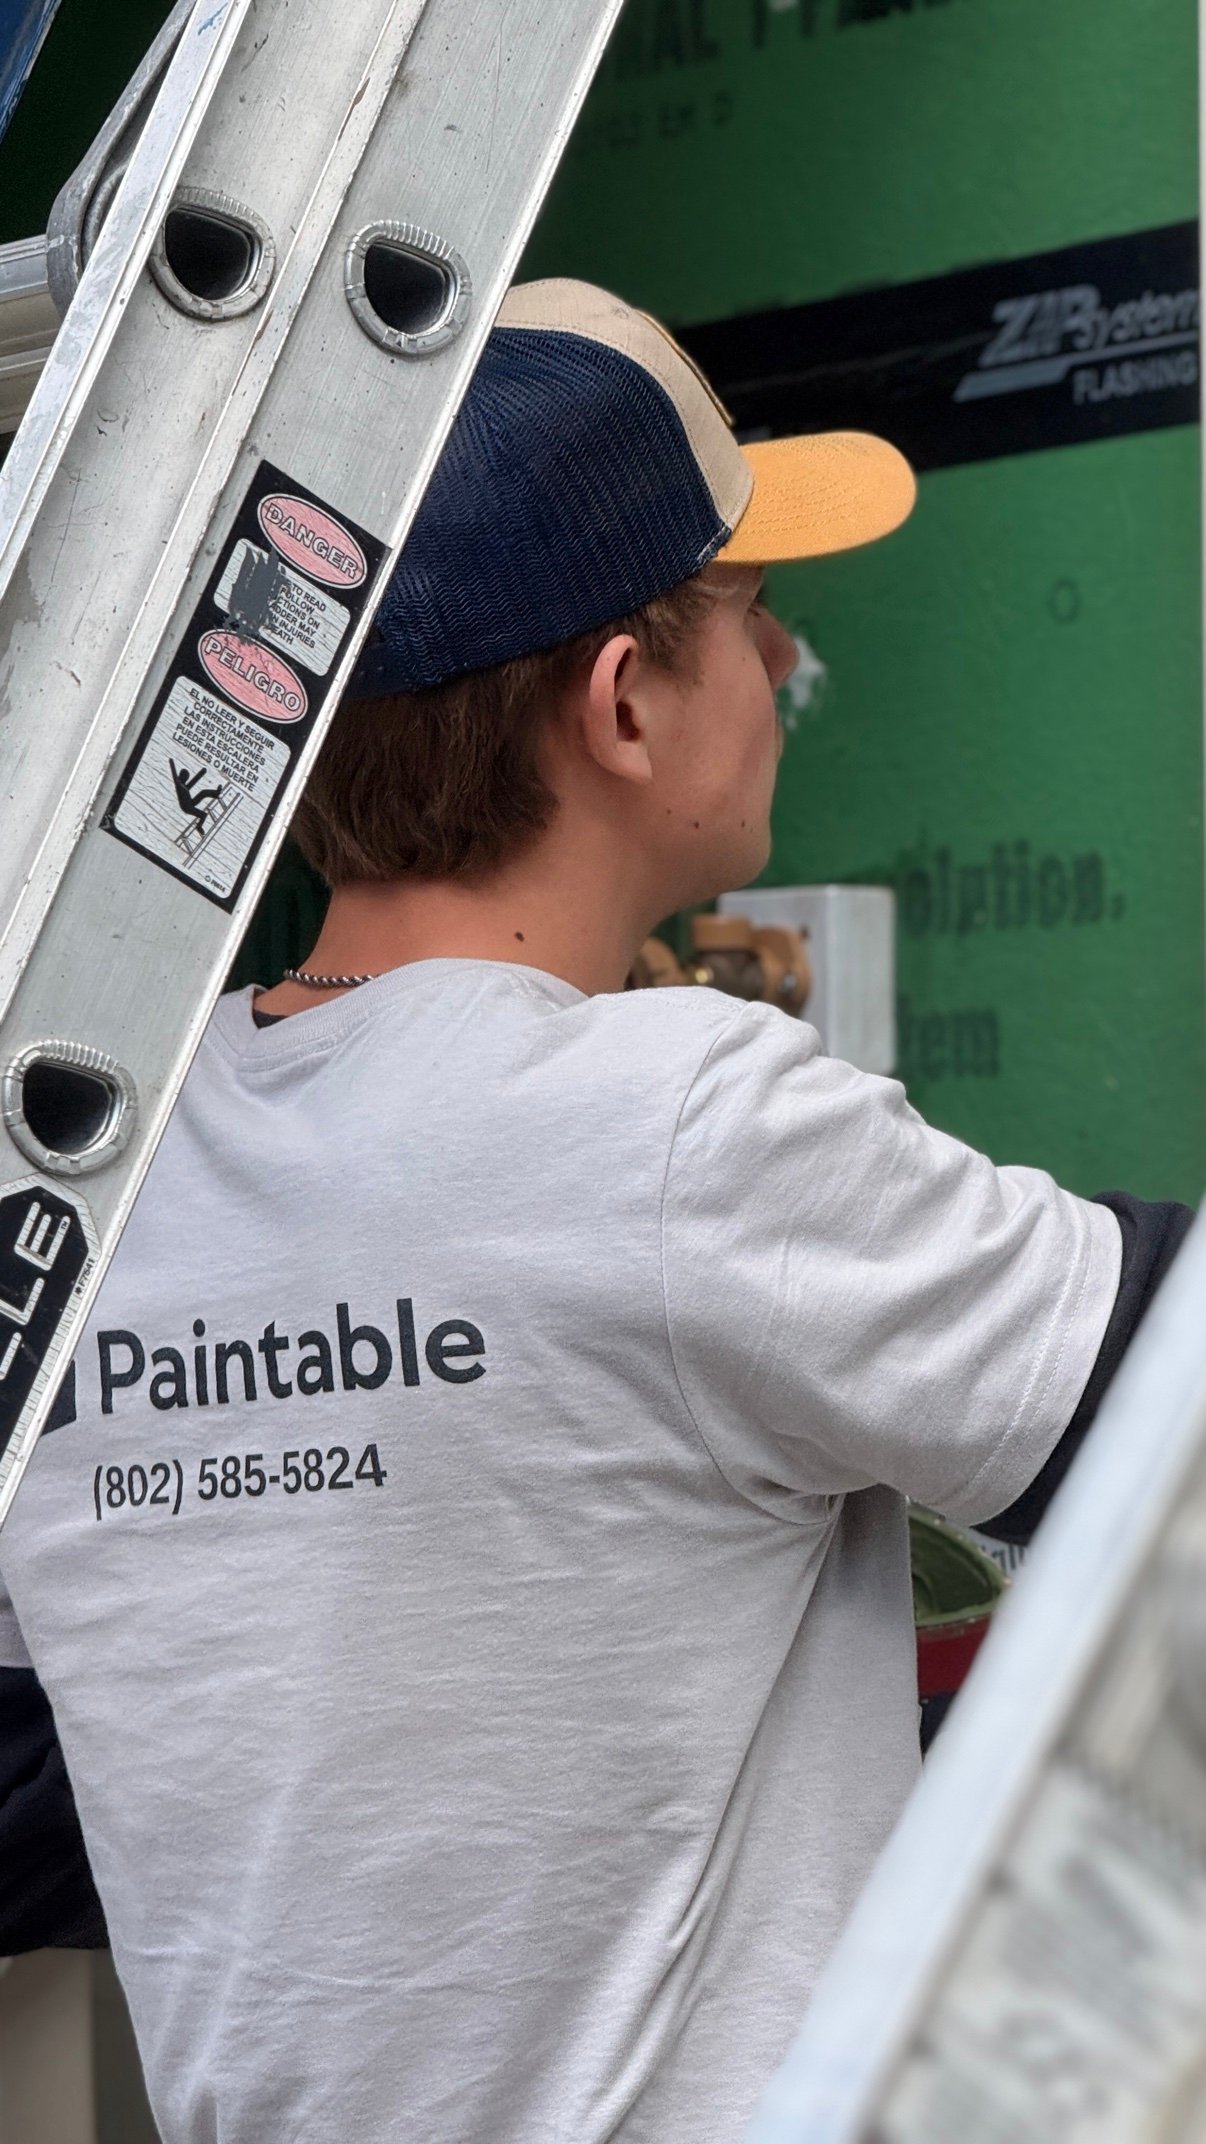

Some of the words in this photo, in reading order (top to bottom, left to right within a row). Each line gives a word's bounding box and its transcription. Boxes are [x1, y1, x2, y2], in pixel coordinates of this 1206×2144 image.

[264, 502, 360, 579] DANGER
[274, 595, 307, 620] CTIONS
[307, 616, 320, 629] ON
[279, 587, 315, 614] FOLLOW
[291, 583, 304, 596] TO
[304, 592, 326, 611] READ
[278, 619, 316, 648] INJURIES
[298, 621, 315, 636] MAY
[204, 637, 300, 711] PELIGRO
[182, 716, 195, 728] EN
[195, 725, 216, 743] ESTA
[216, 739, 259, 772] ESCALERA
[183, 705, 201, 722] LAS
[201, 718, 266, 766] INSTRUCCIONES
[189, 687, 202, 700] EL
[201, 695, 215, 709] NO
[214, 705, 237, 724] LEER
[237, 720, 245, 728] Y
[243, 724, 275, 750] SEGUIR
[193, 701, 264, 753] CORRECTAMENTE
[172, 731, 213, 763] LESIONES
[220, 765, 255, 791] MUERTE
[175, 722, 204, 746] PUEDE
[203, 742, 246, 774] RESULTAR
[246, 771, 258, 783] EN
[97, 1297, 487, 1415] Paintable
[93, 1459, 184, 1521] (802)
[197, 1444, 388, 1501] 585-5824
